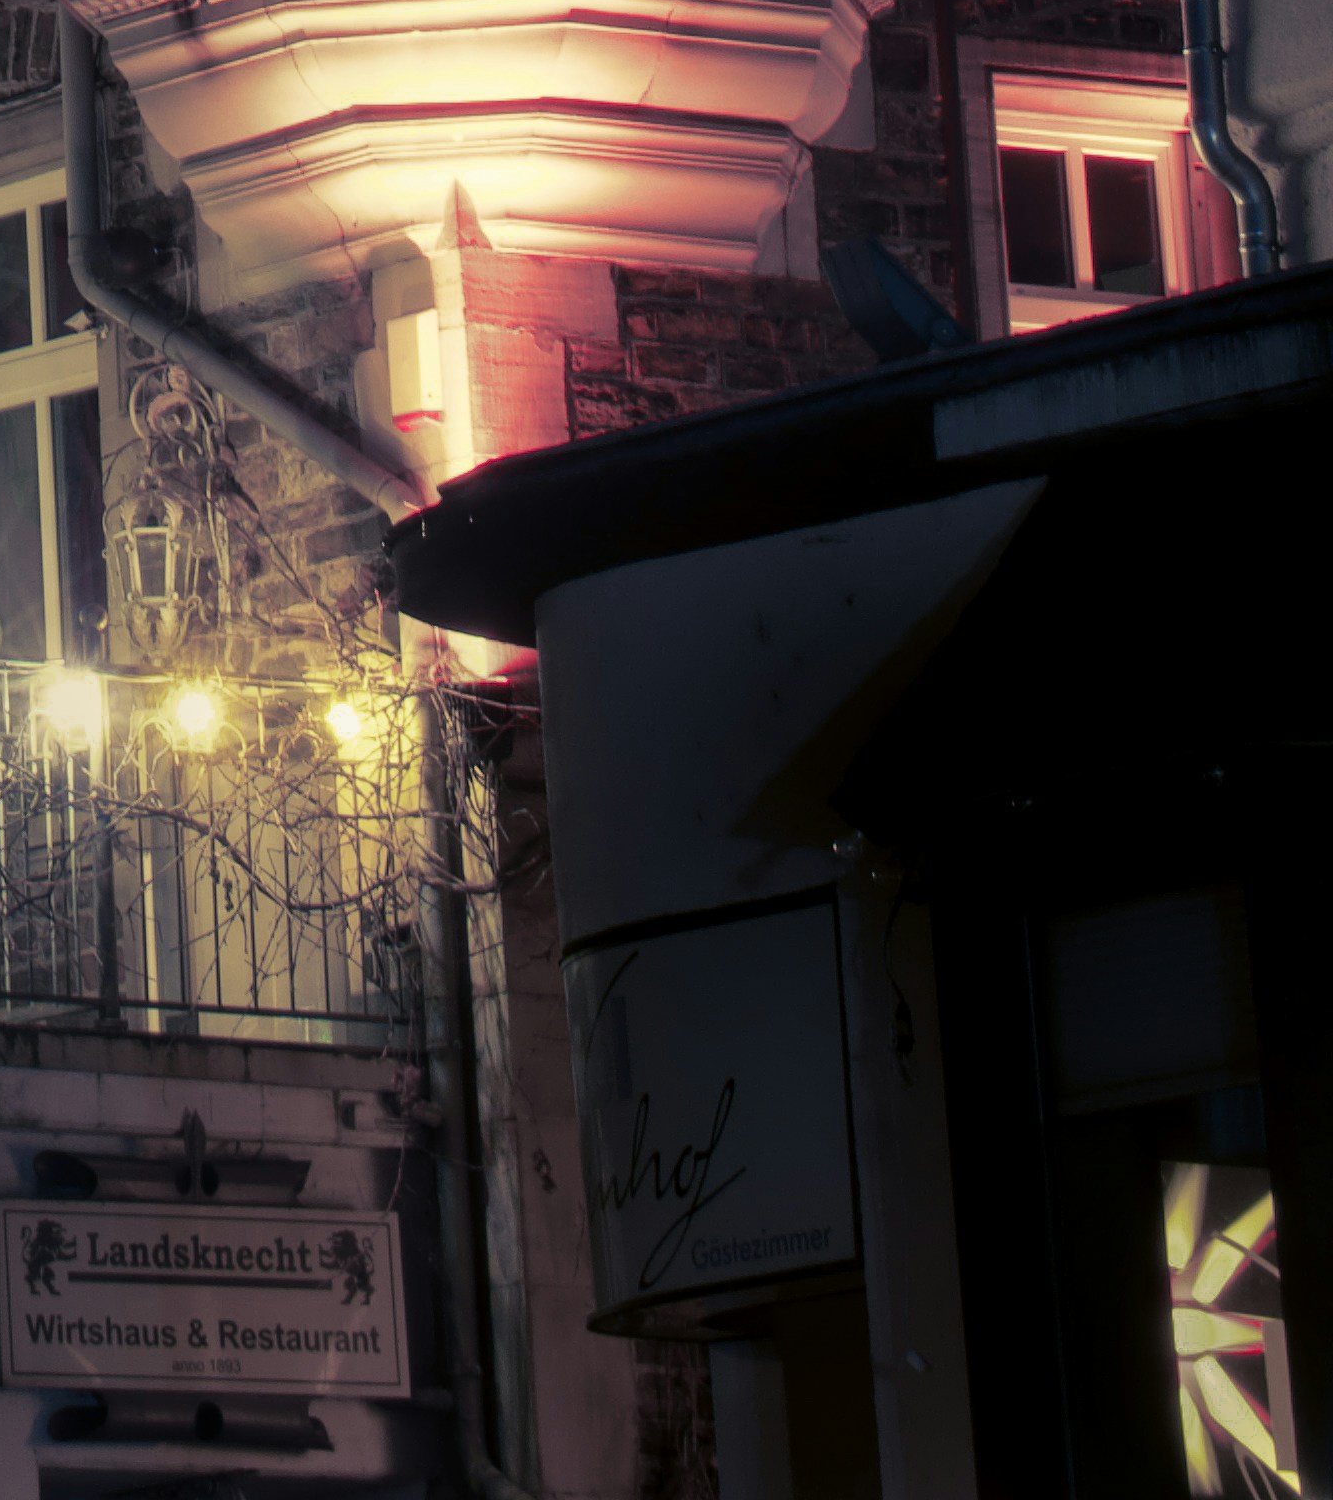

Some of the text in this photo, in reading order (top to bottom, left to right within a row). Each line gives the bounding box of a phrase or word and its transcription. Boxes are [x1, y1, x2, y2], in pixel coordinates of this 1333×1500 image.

[87, 1232, 314, 1273] Landsknecht
[691, 1225, 833, 1270] Gästezimmer
[25, 1313, 382, 1355] Wirtshaus & Restaurant
[171, 1358, 242, 1375] anno 1893
